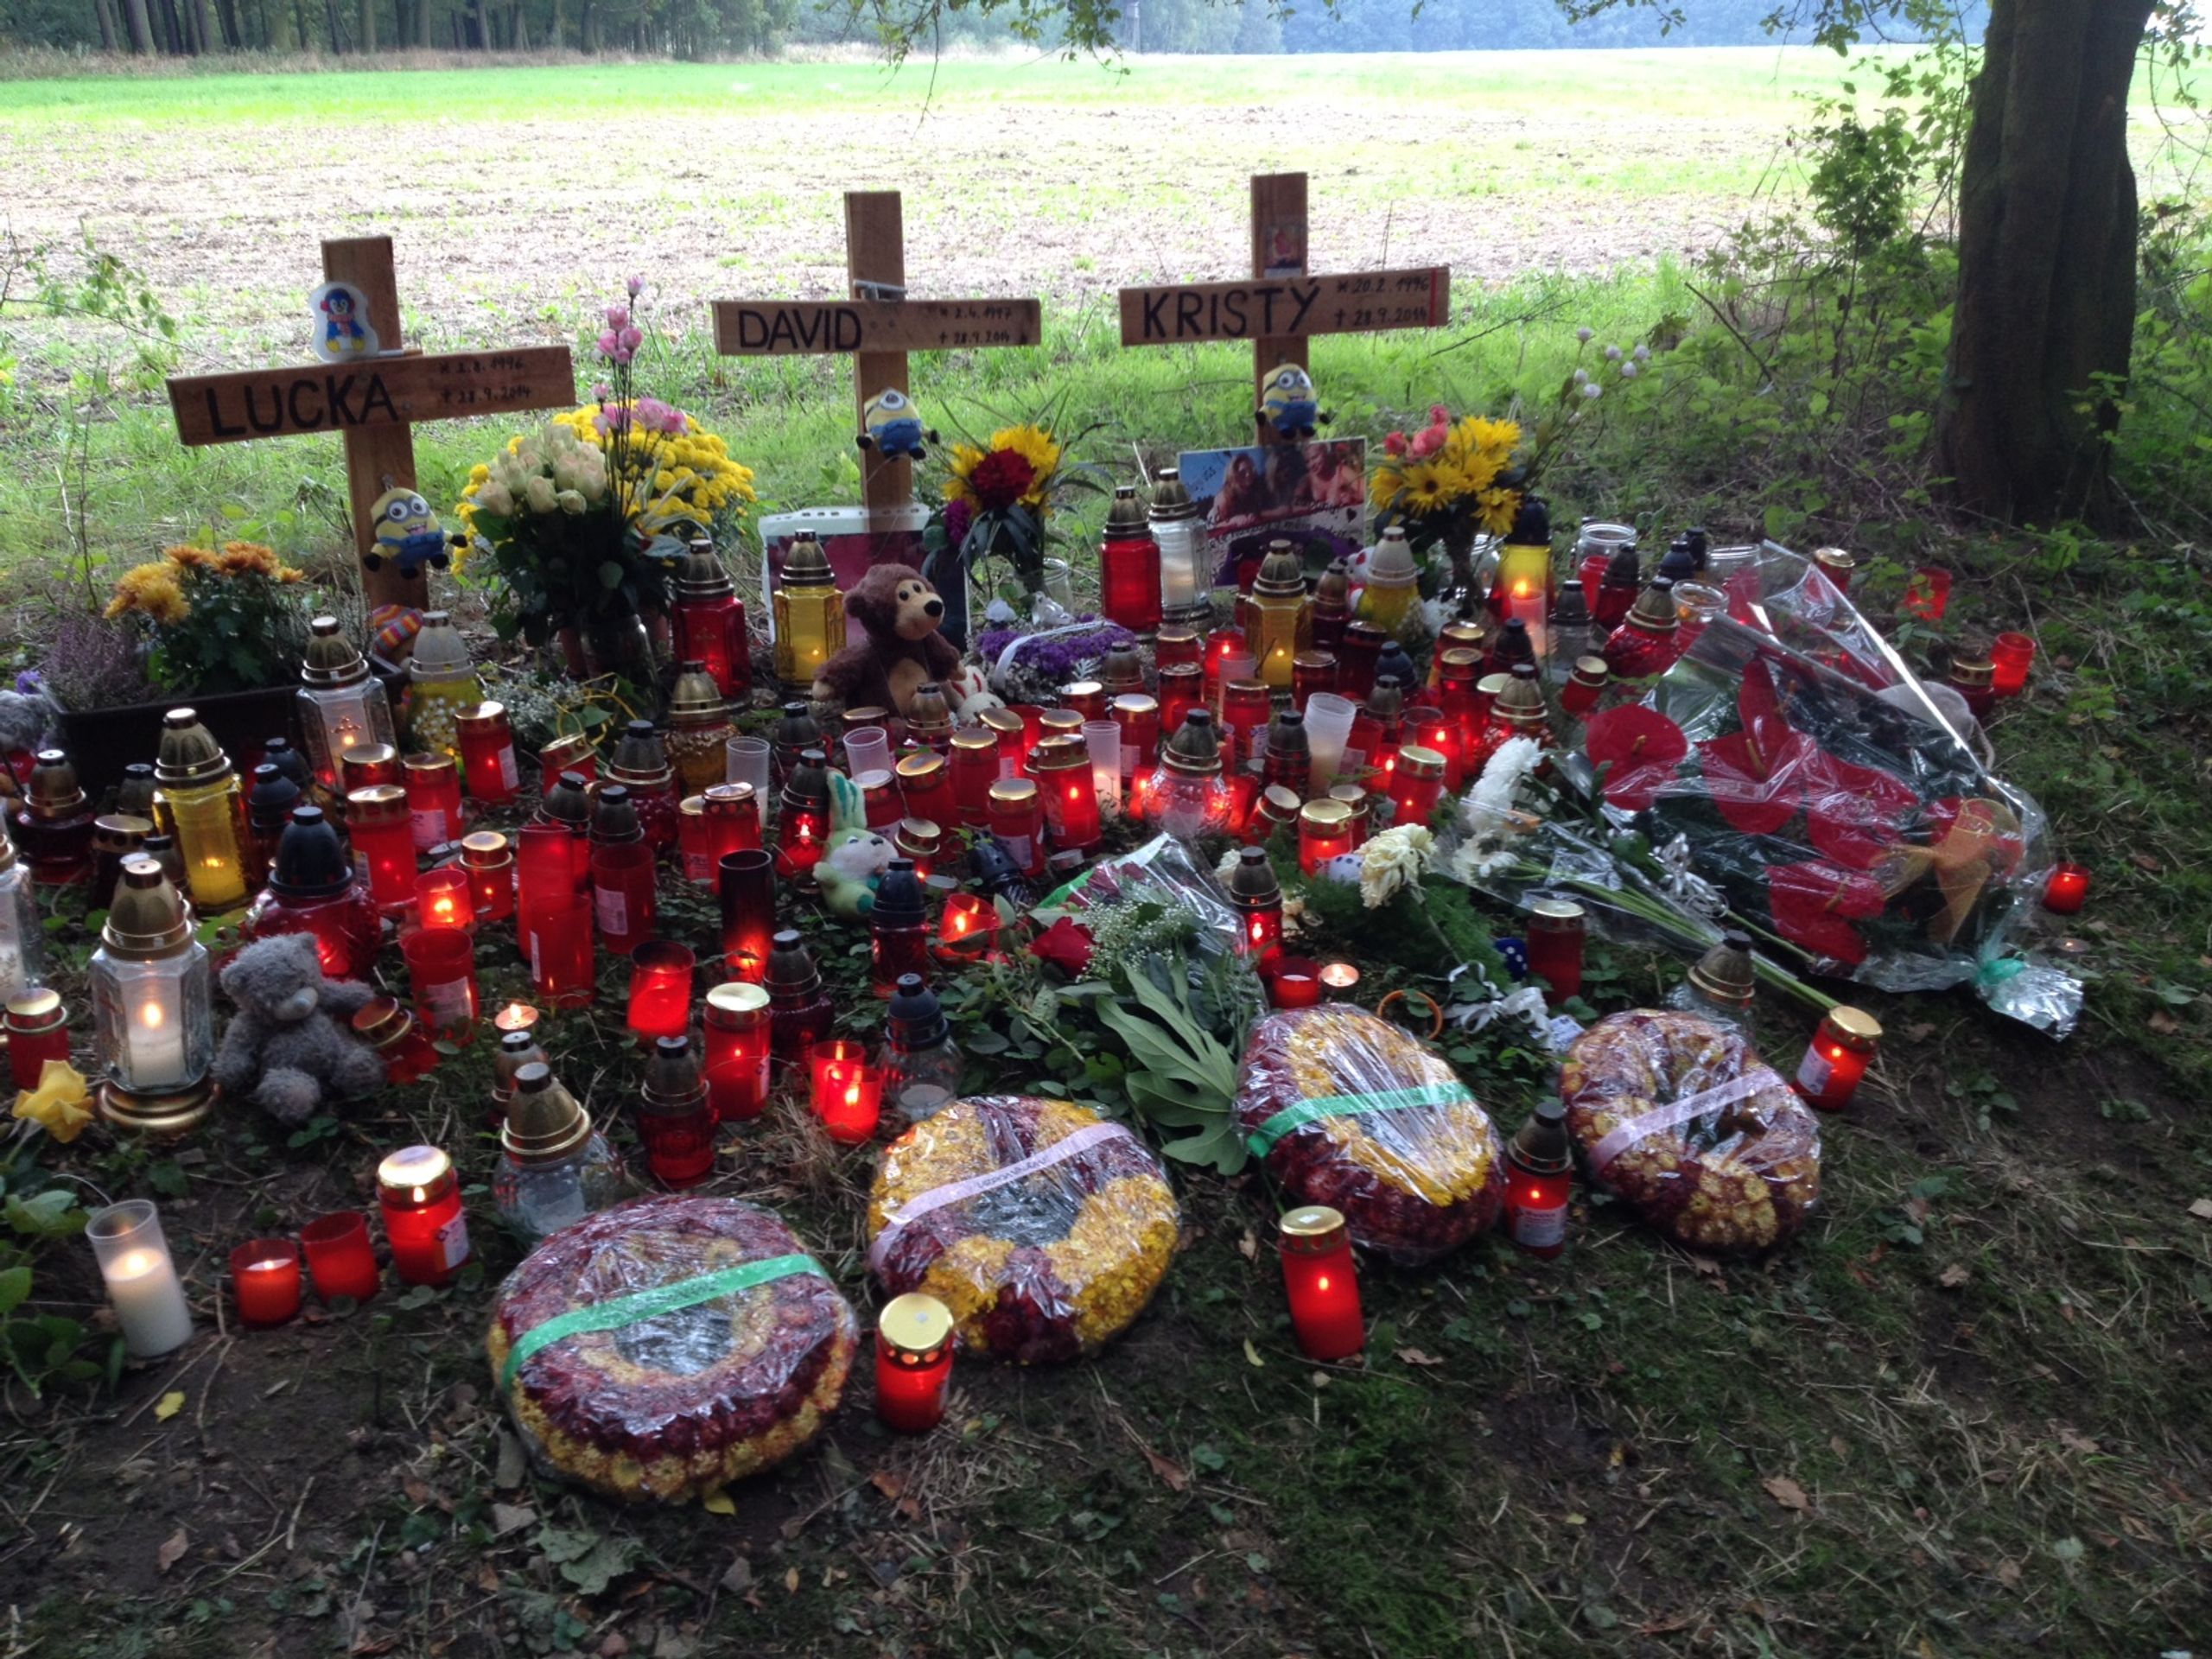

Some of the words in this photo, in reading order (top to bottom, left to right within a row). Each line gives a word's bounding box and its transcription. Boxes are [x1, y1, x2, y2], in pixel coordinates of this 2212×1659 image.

[739, 308, 862, 352] DAVID
[1143, 277, 1320, 339] KRISTÝ
[206, 372, 399, 436] LUCKA
